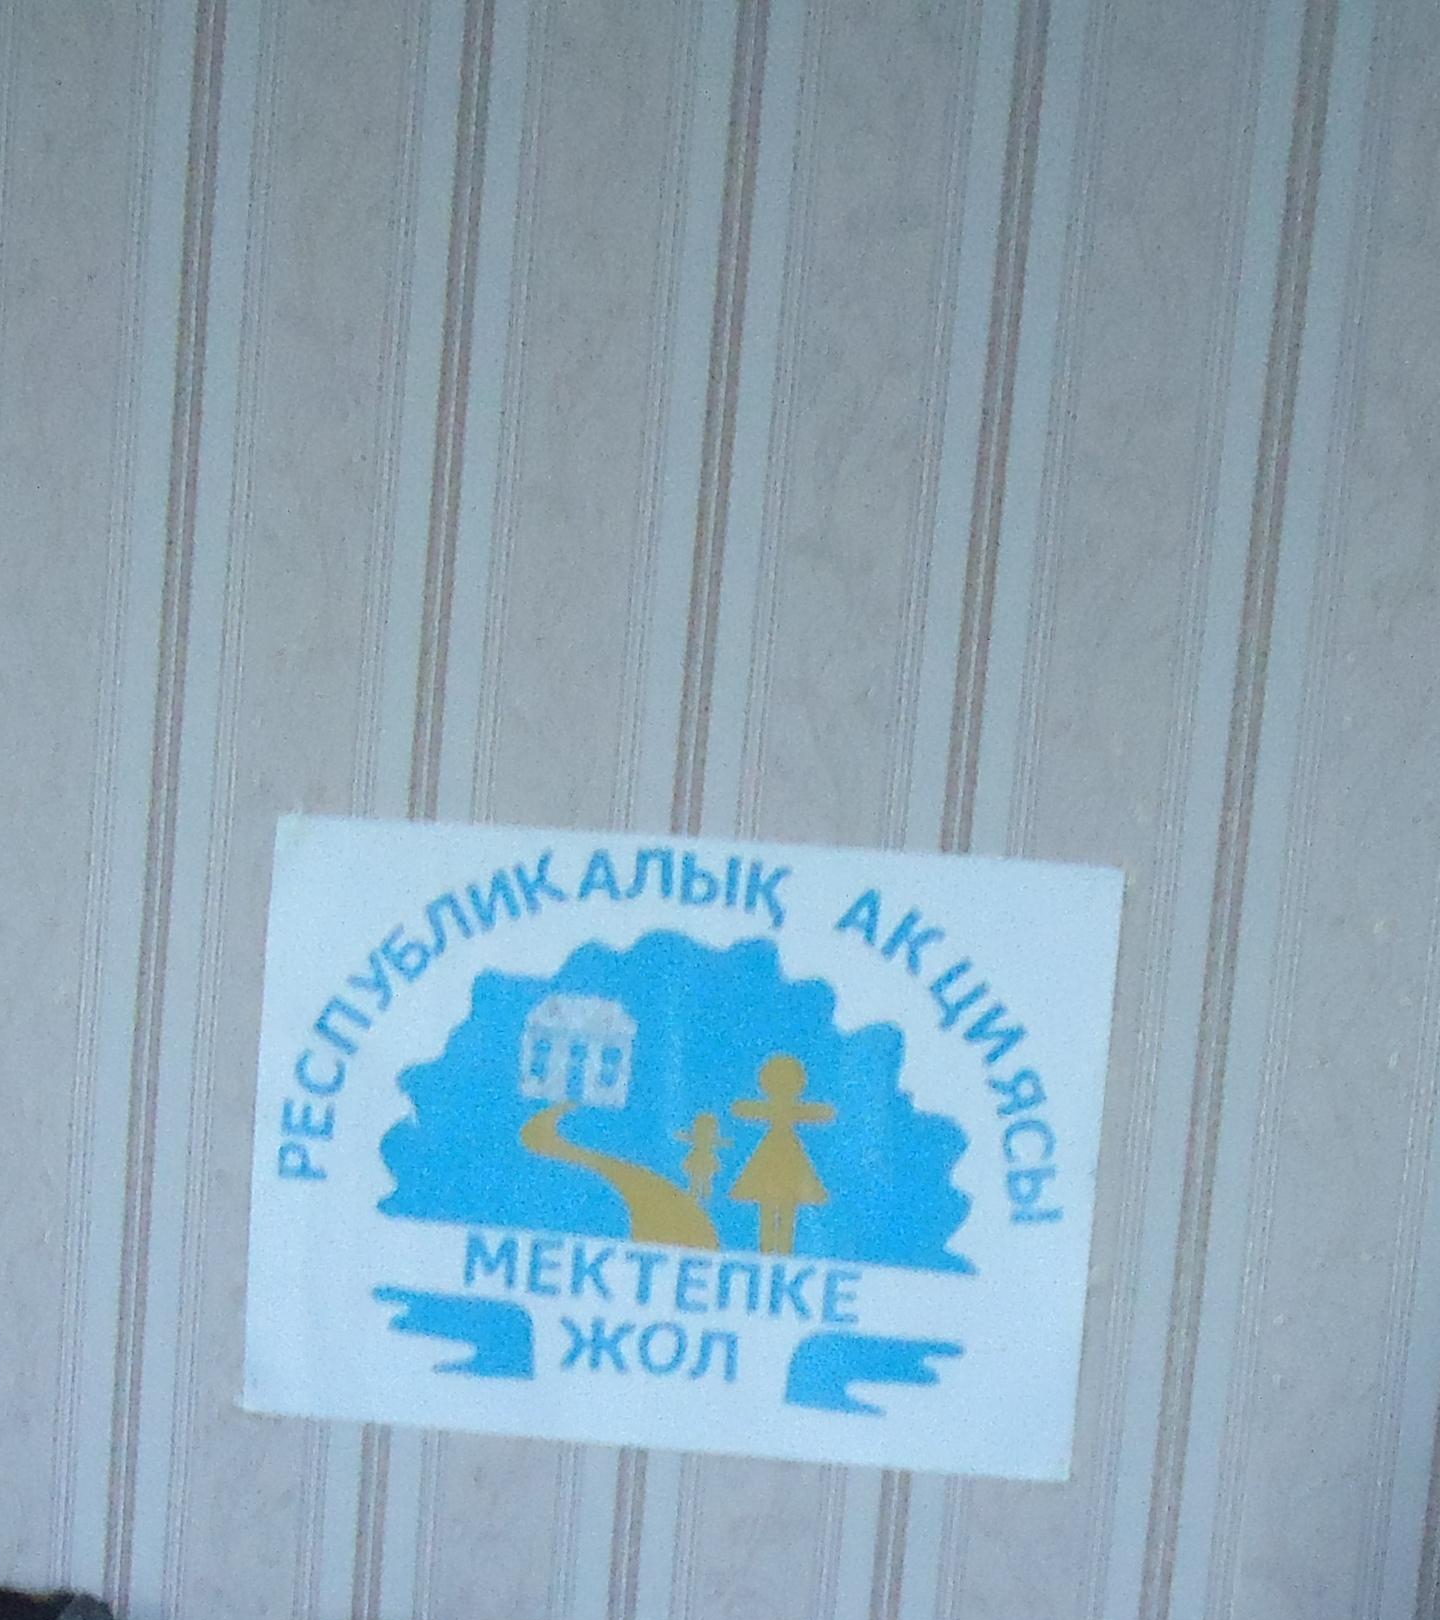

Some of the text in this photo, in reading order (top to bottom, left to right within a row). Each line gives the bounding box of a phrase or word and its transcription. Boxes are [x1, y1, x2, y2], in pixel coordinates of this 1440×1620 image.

[277, 848, 1064, 1226] РЕСПУБЛИКАЛЫҚ АКЦИЯСЫ
[464, 1233, 861, 1324] МЕКТЕПКЕ
[561, 1317, 739, 1382] ЖОЛ
